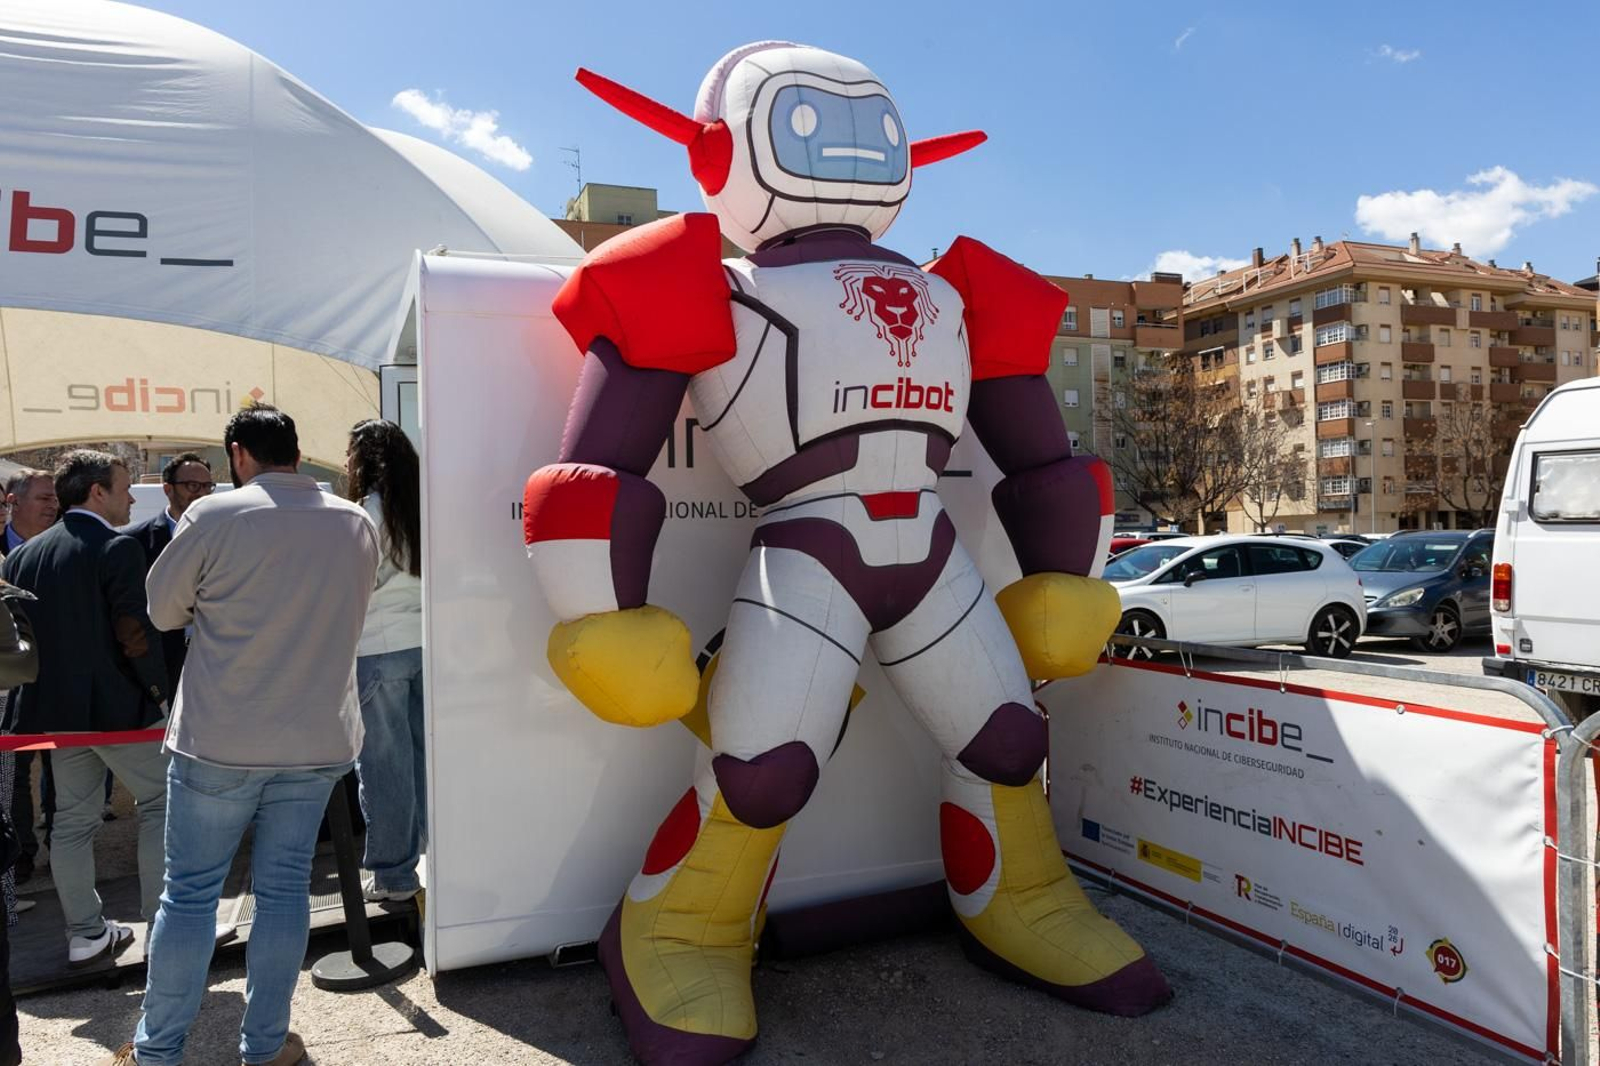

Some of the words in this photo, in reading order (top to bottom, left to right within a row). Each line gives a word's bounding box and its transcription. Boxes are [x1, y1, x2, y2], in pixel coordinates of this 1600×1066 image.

[5, 189, 234, 267] be_
[832, 376, 954, 414] incibot
[664, 502, 728, 519] IONAL
[734, 502, 757, 518] DE
[1537, 673, 1575, 690] 8421
[1149, 733, 1183, 750] INSTITUTO
[1184, 743, 1220, 760] NACIONAL
[1222, 751, 1231, 763] DE
[1233, 755, 1305, 779] CIBERSEGURIDAD
[1130, 775, 1364, 866] #ExperienciaINCIBE
[1289, 901, 1335, 932] España
[1343, 923, 1384, 951] digital
[1437, 953, 1457, 968] 017
